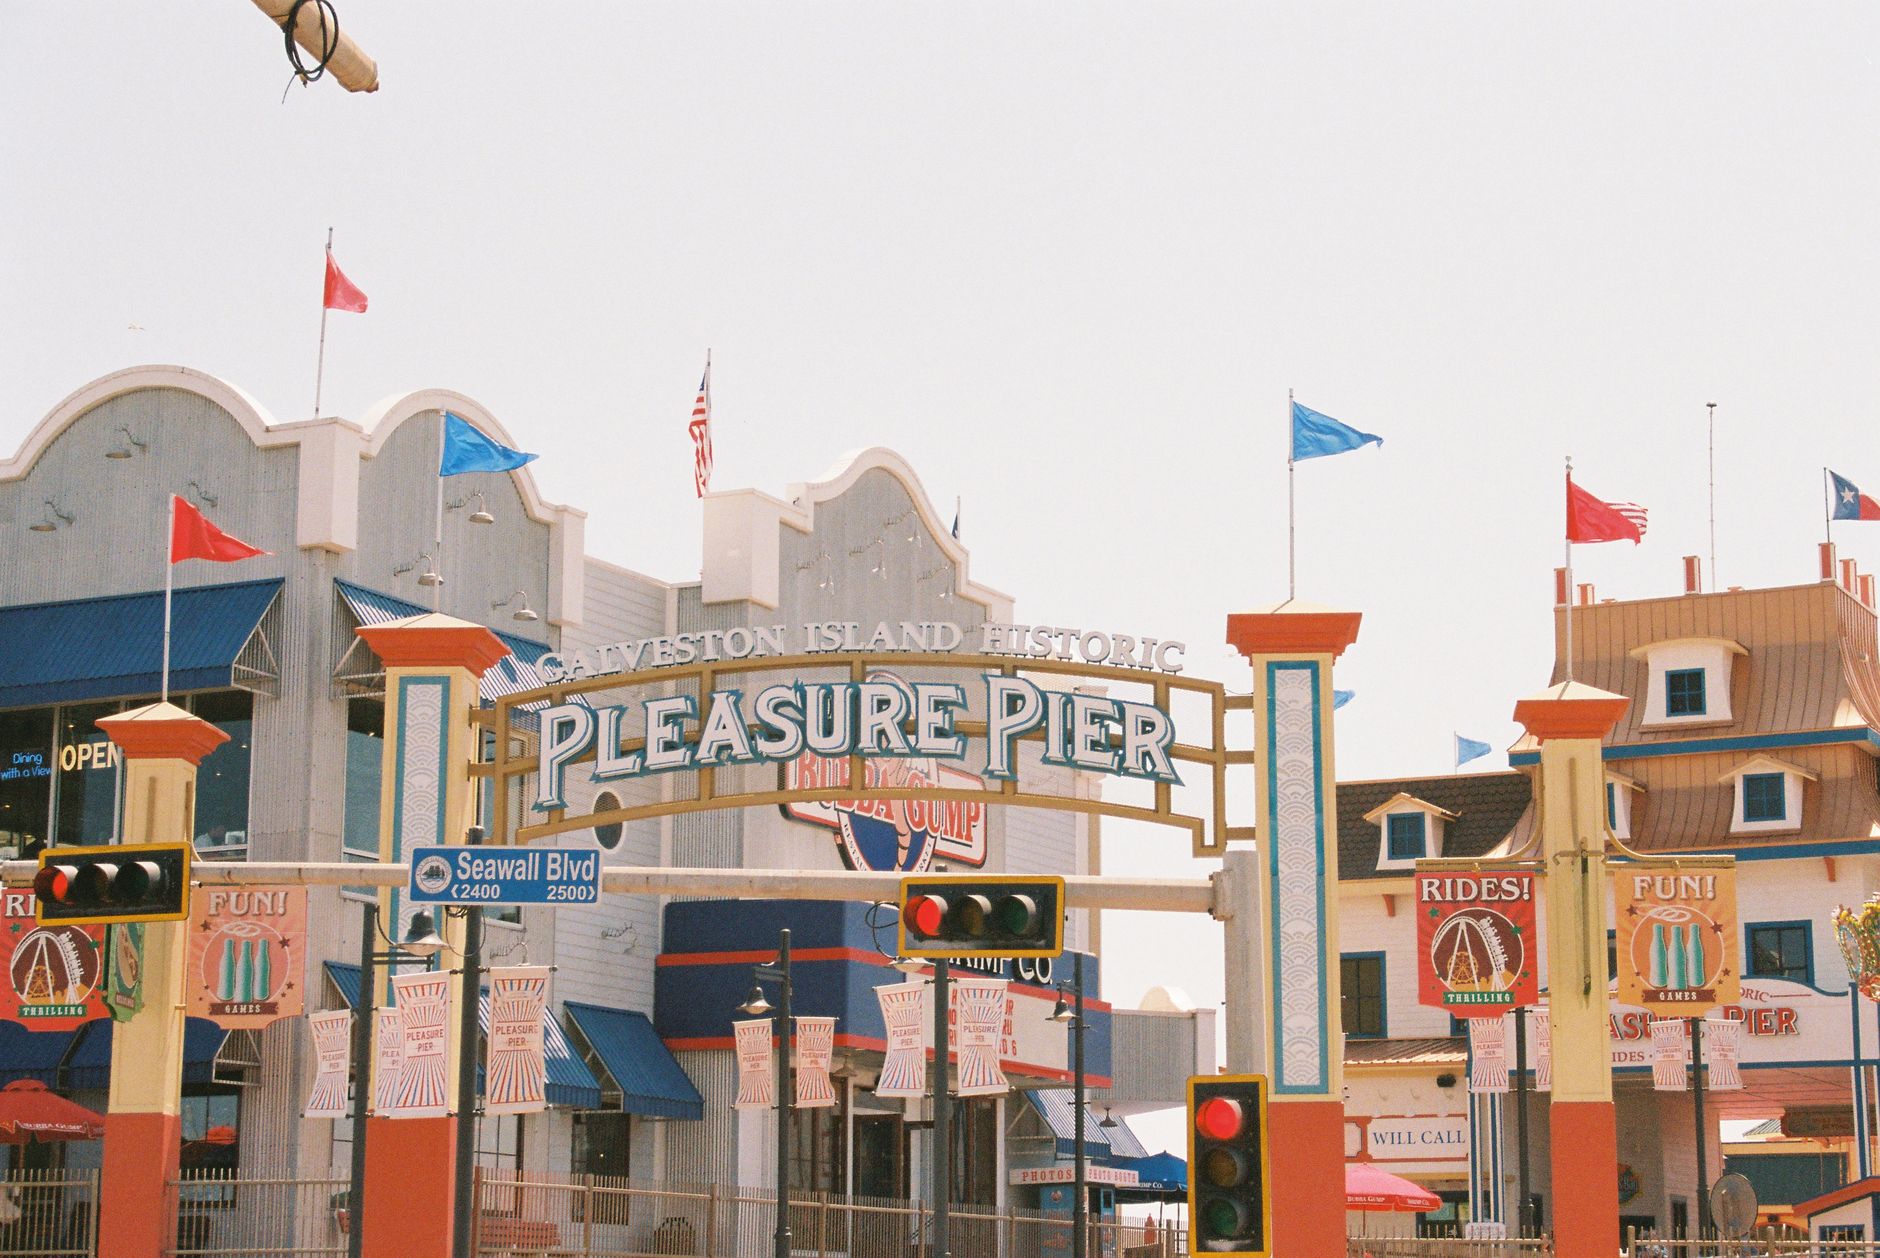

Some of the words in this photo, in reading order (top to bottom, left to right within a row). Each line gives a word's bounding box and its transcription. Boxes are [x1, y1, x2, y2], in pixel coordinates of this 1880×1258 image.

[535, 624, 786, 685] GALVESTON
[803, 621, 963, 652] ISLAND
[979, 622, 1185, 673] HISTORIC
[532, 679, 968, 812] PLEASURE
[981, 674, 1185, 786] PIER
[12, 752, 43, 765] Dining
[61, 741, 118, 771] OPEN
[0, 767, 20, 780] with
[23, 769, 30, 777] a
[31, 766, 53, 777] View
[457, 851, 539, 881] Seawall
[546, 853, 595, 881] Blvd
[460, 884, 500, 899] 2400
[547, 886, 587, 900] 2500
[1421, 876, 1530, 902] RIDES!
[1632, 875, 1717, 900] FUN!
[208, 891, 288, 917] FUN!
[1448, 992, 1511, 1003] THRILLING
[1659, 992, 1697, 1000] GAMES
[22, 1006, 83, 1016] THRILLING
[225, 1004, 261, 1013] GAMES
[1723, 1005, 1800, 1036] PIER
[407, 1029, 444, 1041] PLEASURE
[496, 1024, 538, 1035] PLEASURE
[892, 1027, 920, 1037] PLEASURE
[418, 1042, 433, 1052] PIER
[508, 1037, 526, 1047] PIER
[322, 1052, 345, 1061] PLEASURE
[382, 1050, 400, 1058] PLEA
[1612, 1051, 1645, 1062] IDES
[1373, 1131, 1416, 1145] WILL
[1421, 1130, 1466, 1144] CALL
[1022, 1169, 1072, 1182] PHOTOS
[1088, 1168, 1111, 1180] PHOTO
[1114, 1171, 1137, 1183] BOOTH
